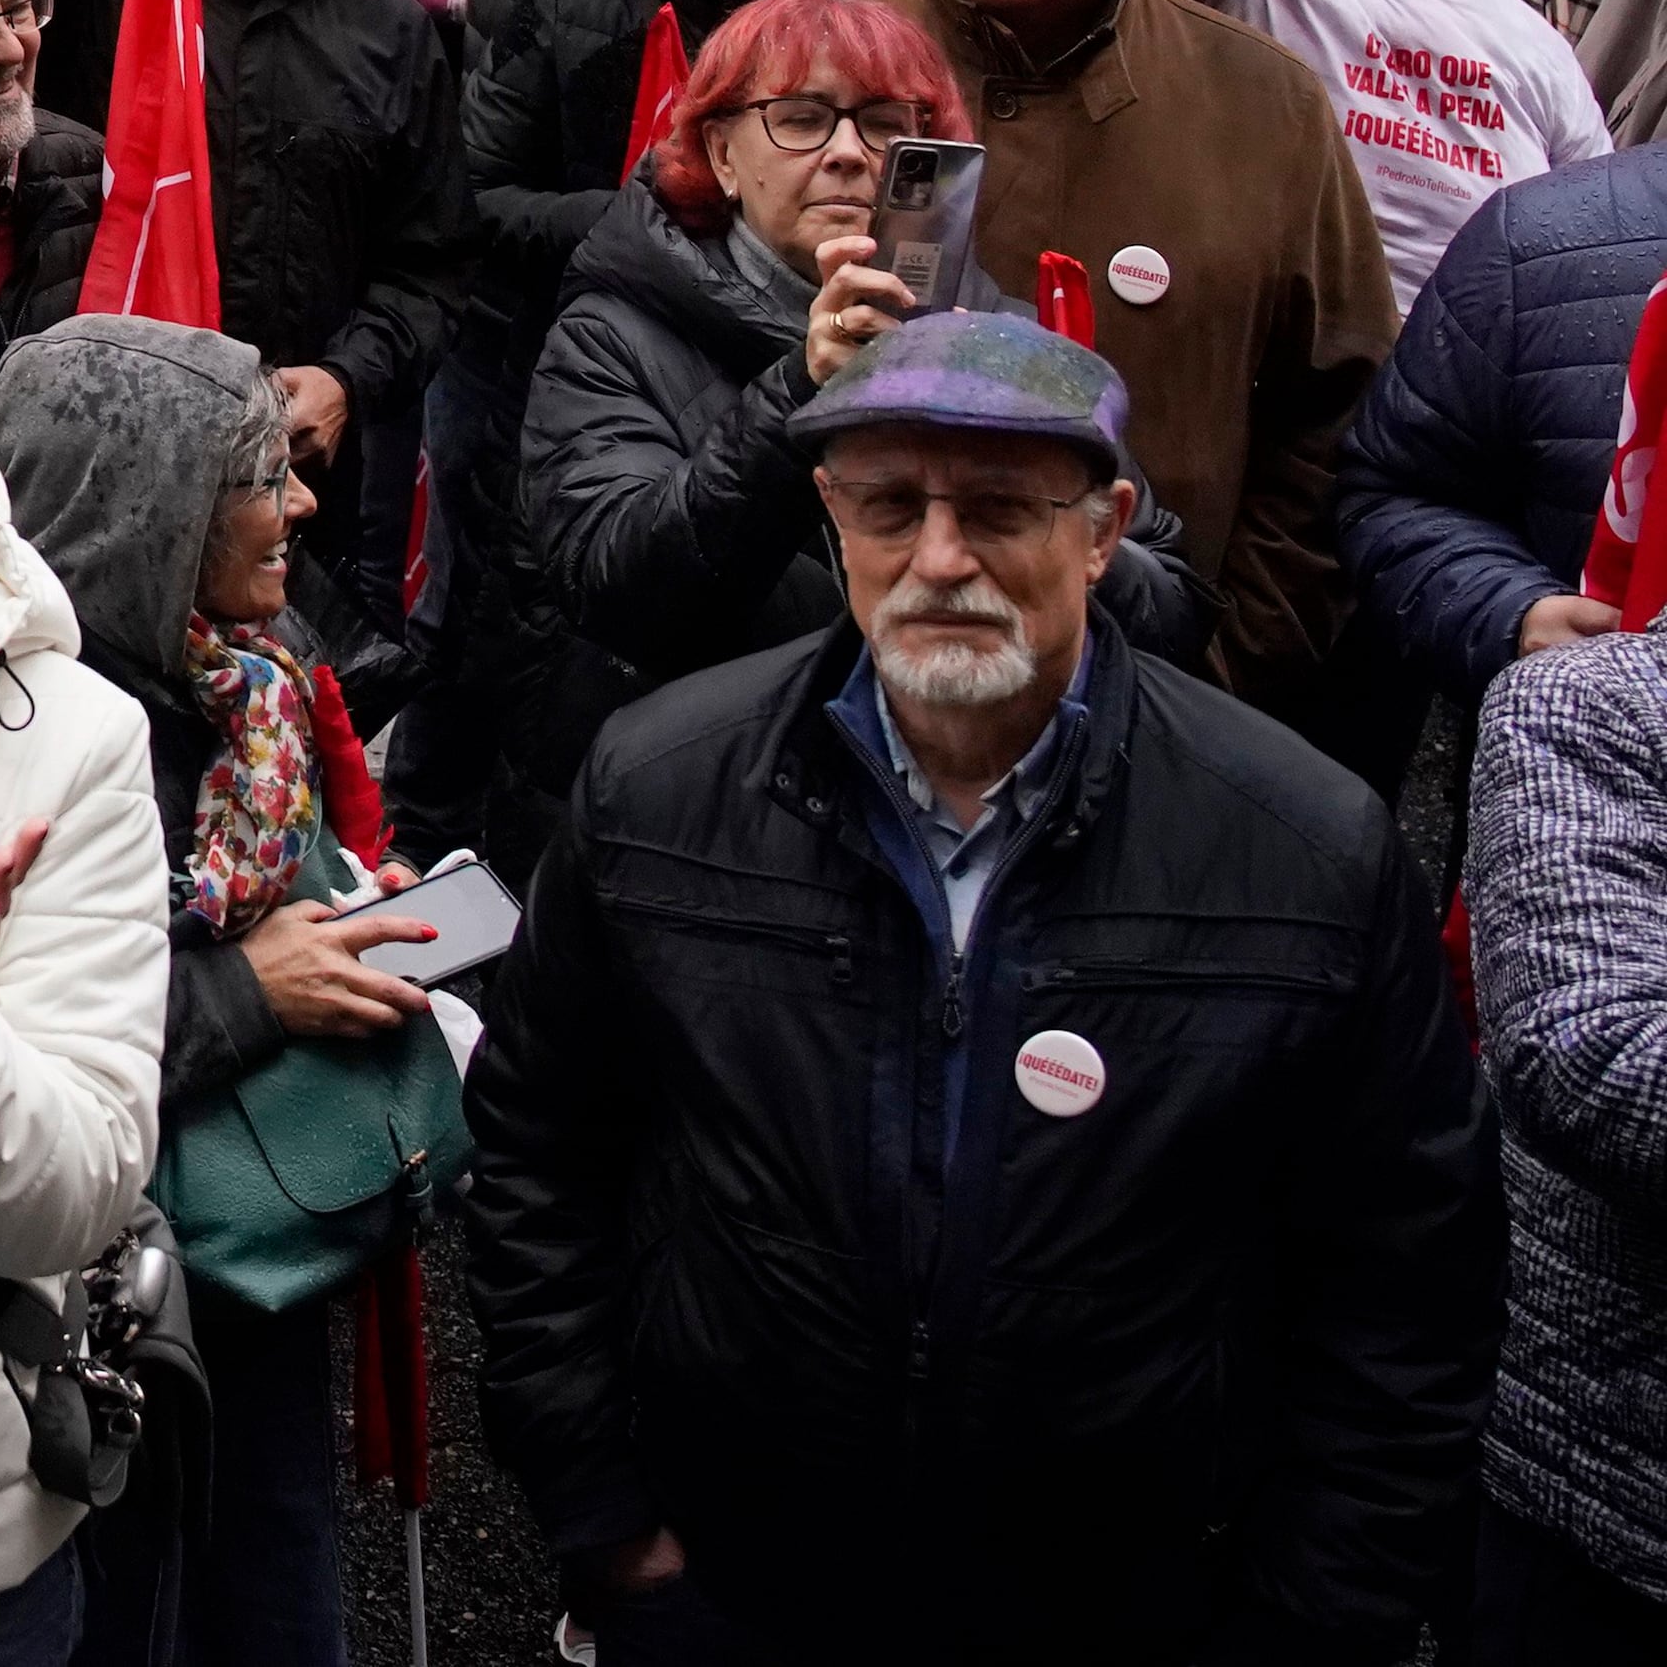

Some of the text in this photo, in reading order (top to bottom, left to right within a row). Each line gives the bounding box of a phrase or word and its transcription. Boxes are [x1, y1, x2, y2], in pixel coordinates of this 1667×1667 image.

[1440, 55, 1492, 90] QUE
[1344, 62, 1405, 102] VALE
[1440, 92, 1505, 132] PENA
[1344, 110, 1504, 180] ¡QUÉÉÉDATE!
[1112, 262, 1167, 286] ¡QUÉÉÉDATE!
[1018, 1052, 1099, 1092] ¡QUÉÉÉDATE!
